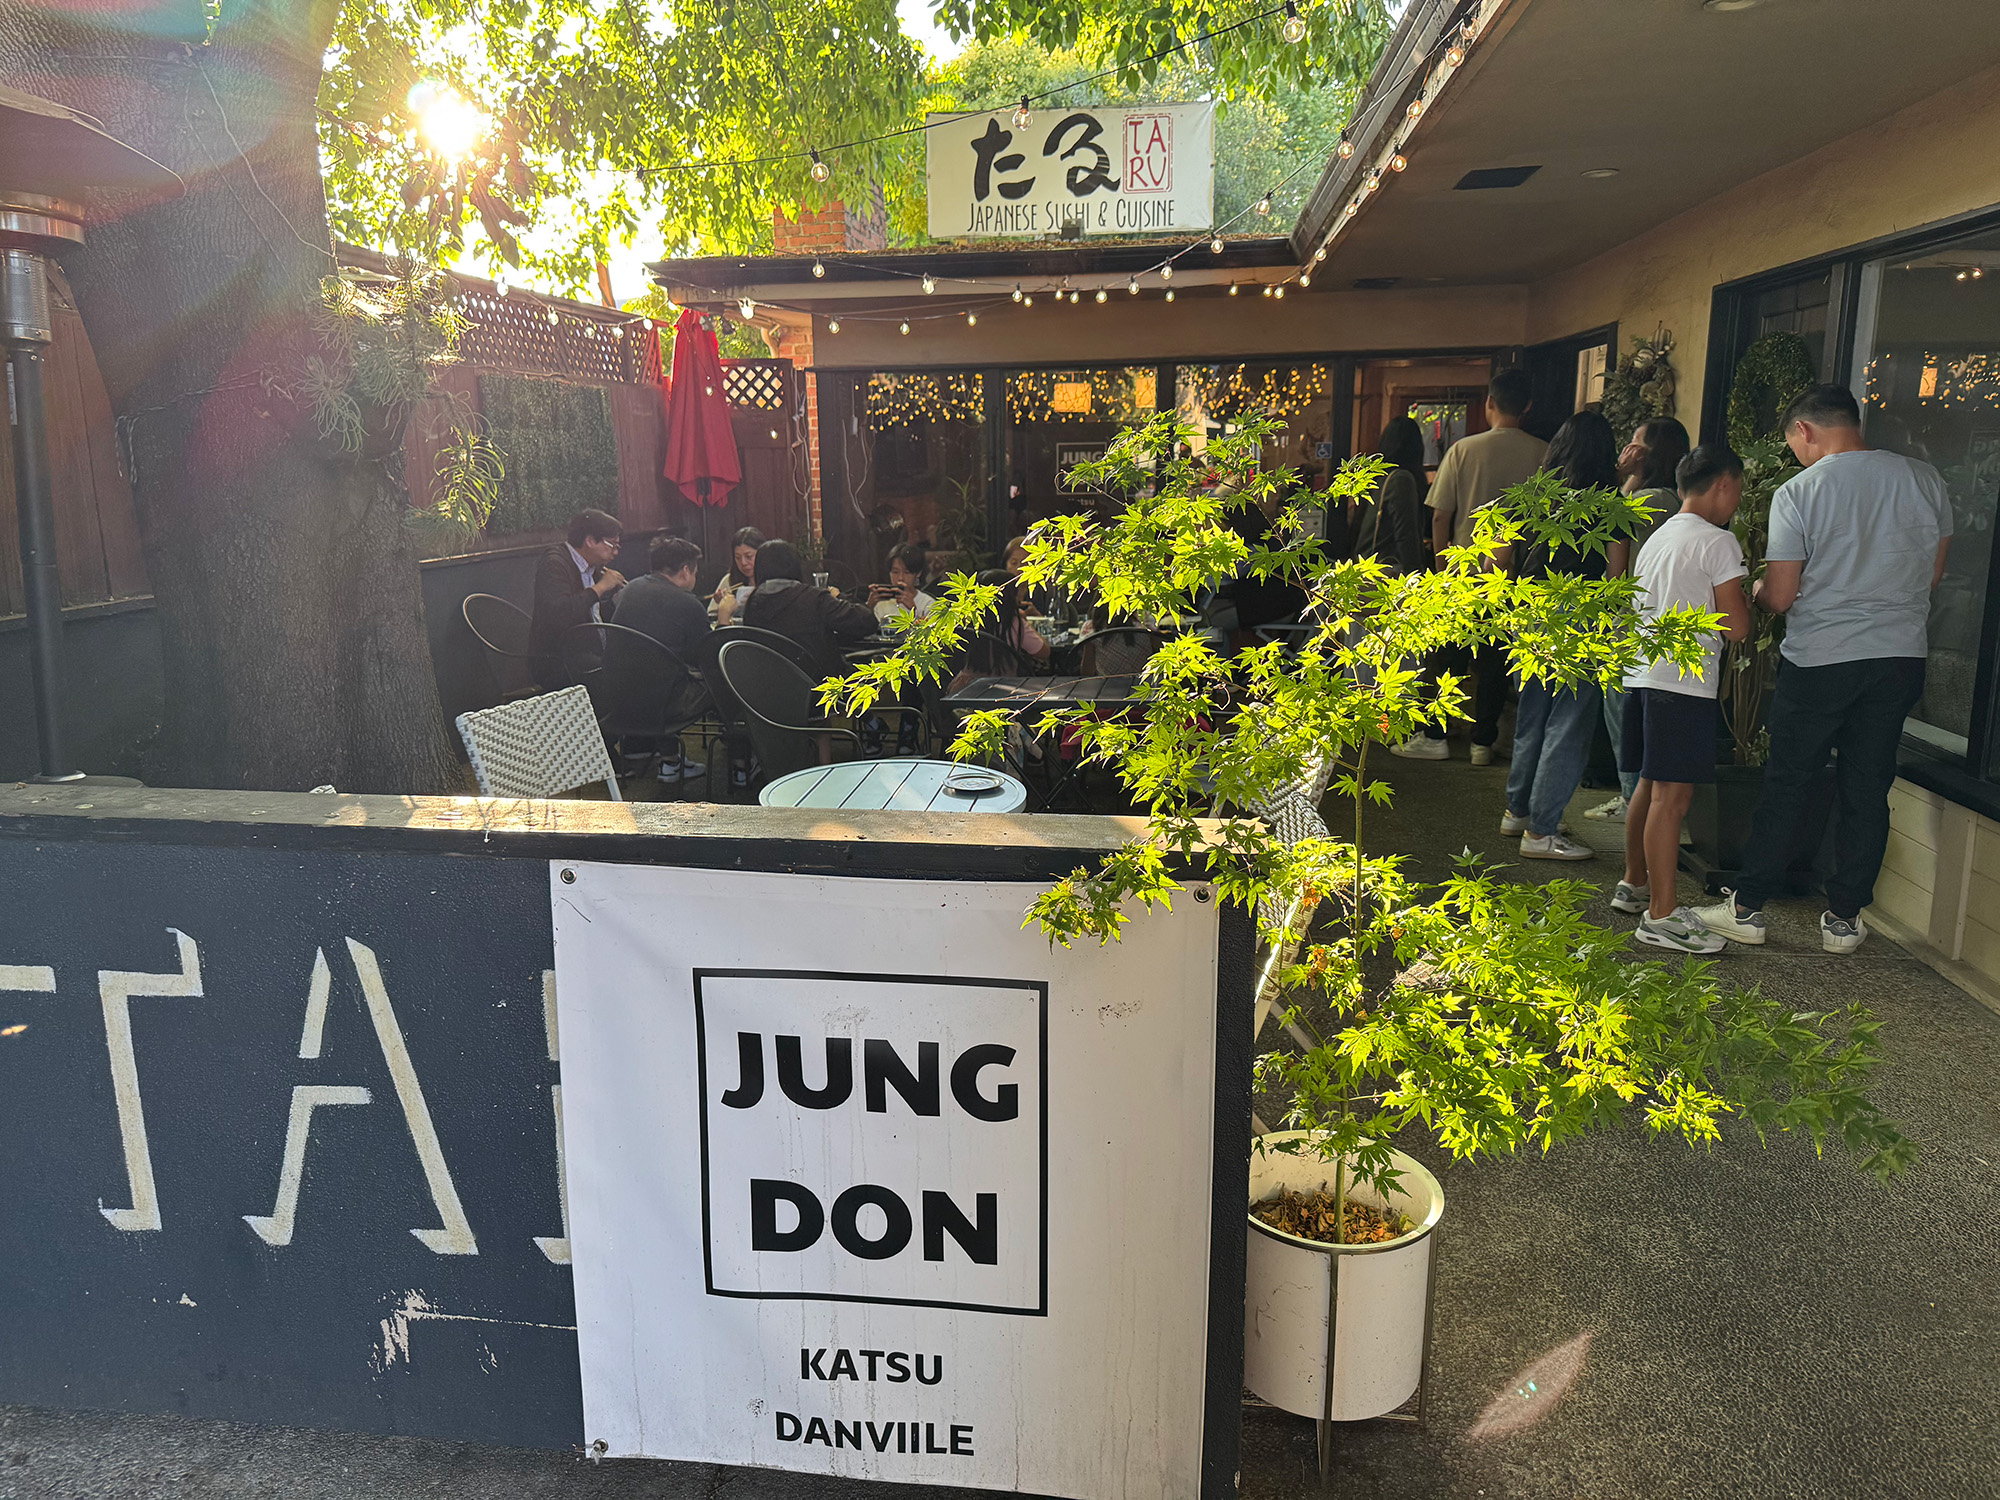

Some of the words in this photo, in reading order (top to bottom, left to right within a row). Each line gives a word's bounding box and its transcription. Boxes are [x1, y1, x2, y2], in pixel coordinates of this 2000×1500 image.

[970, 113, 1122, 202] たる
[1129, 119, 1166, 155] TA
[1098, 202, 1108, 227] &
[1116, 198, 1175, 228] CUISINE
[720, 1031, 1020, 1122] JUNG
[750, 1178, 998, 1266] DON
[800, 1348, 943, 1385] KATSU
[775, 1411, 975, 1456] DANVIILE
